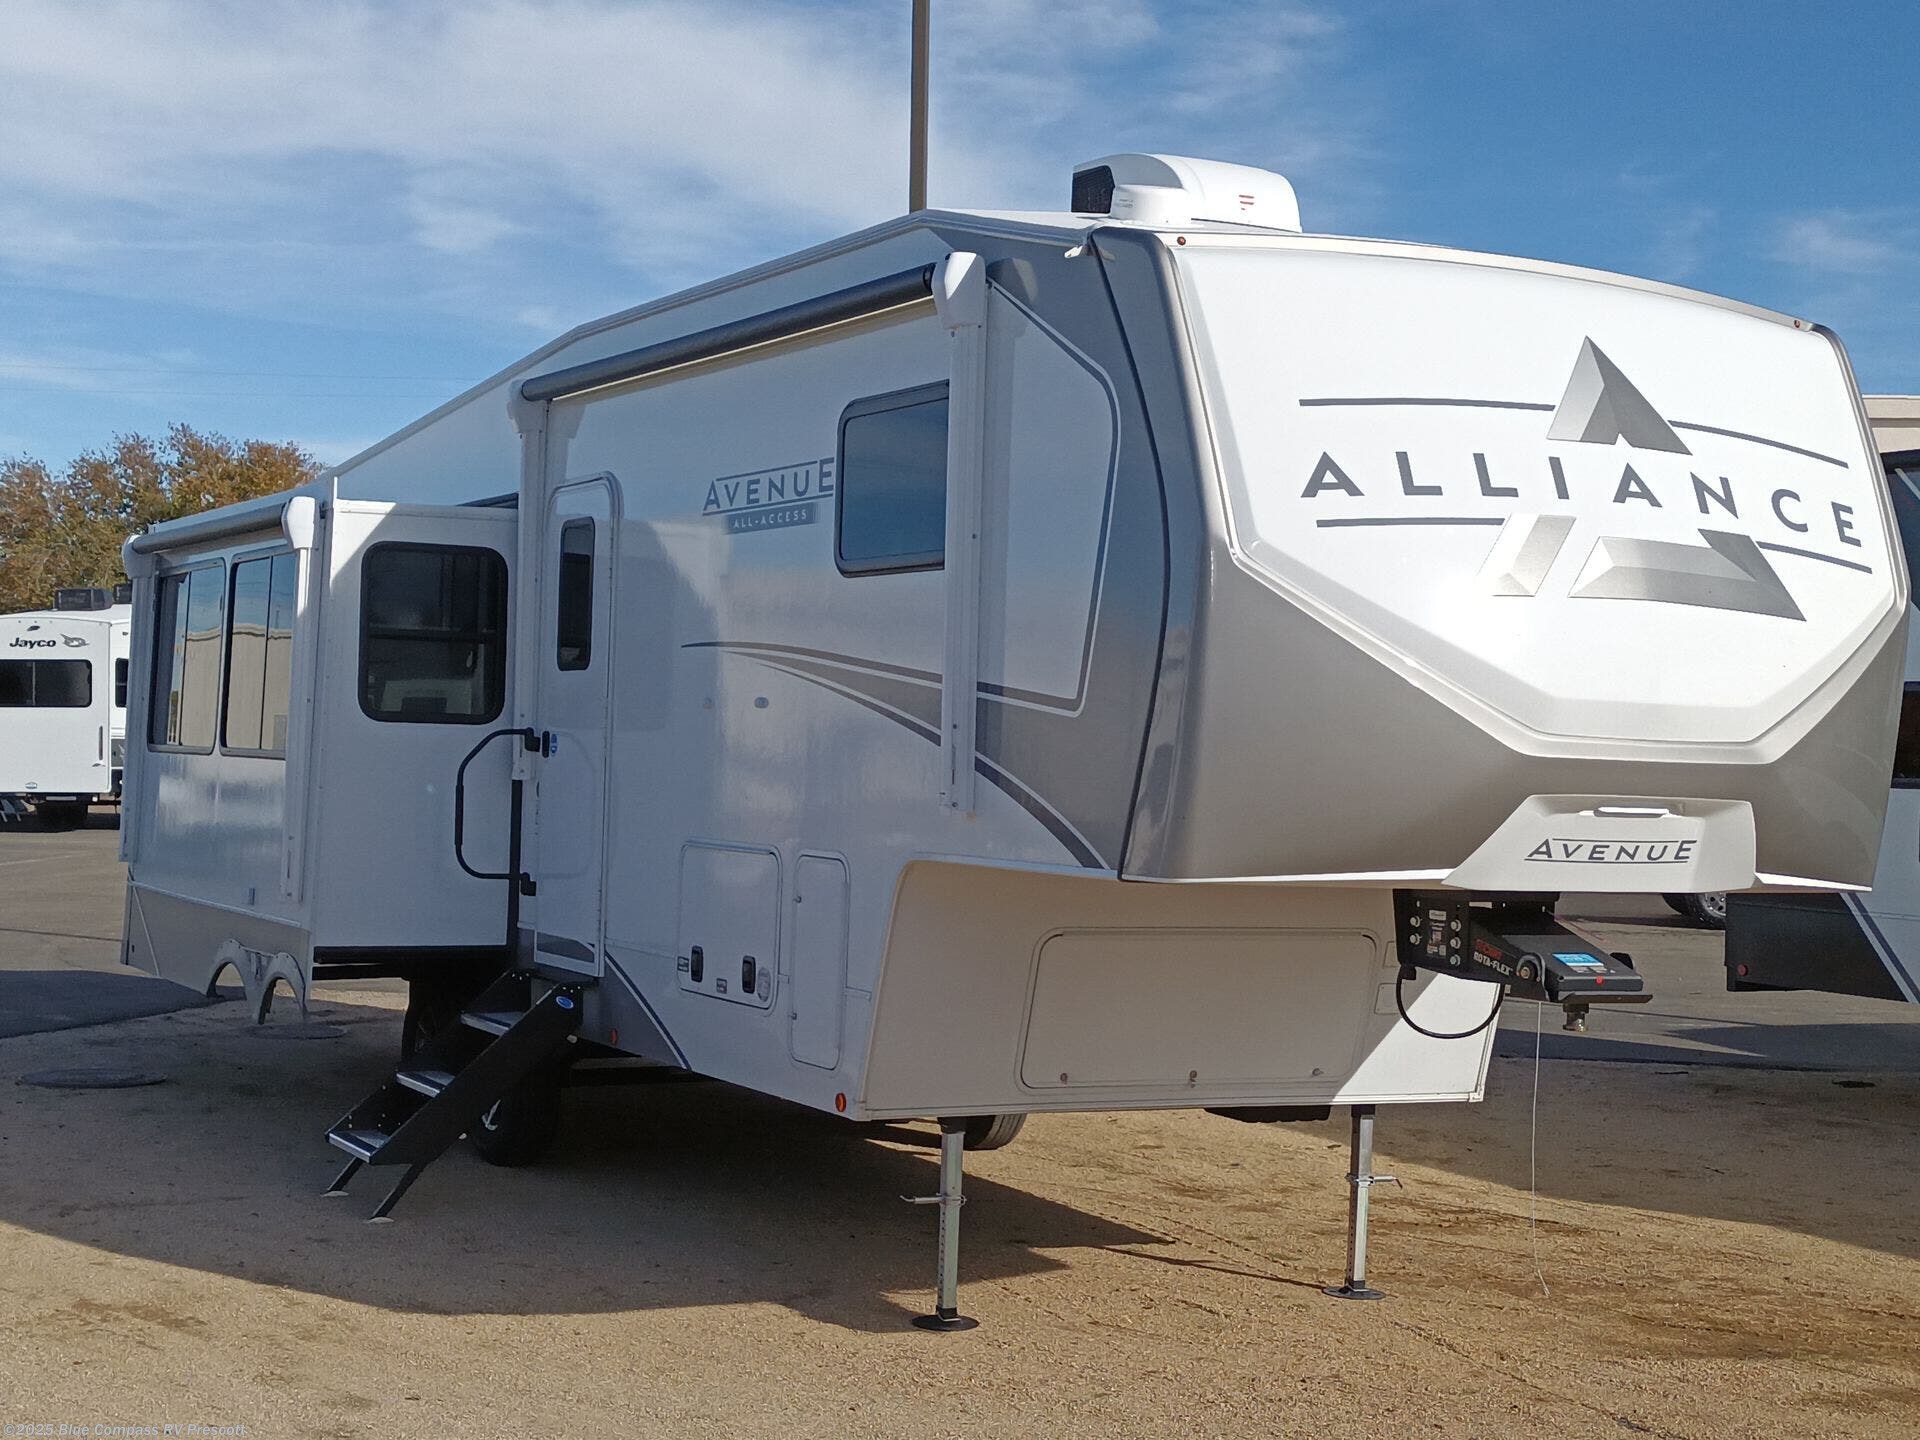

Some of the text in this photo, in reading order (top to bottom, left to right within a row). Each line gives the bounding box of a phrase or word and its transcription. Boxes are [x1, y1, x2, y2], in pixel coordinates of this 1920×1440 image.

[703, 457, 835, 511] AVENUE
[1300, 451, 1862, 547] ALLIANCE
[9, 637, 57, 649] Jayco
[1527, 839, 1697, 861] AVENUE
